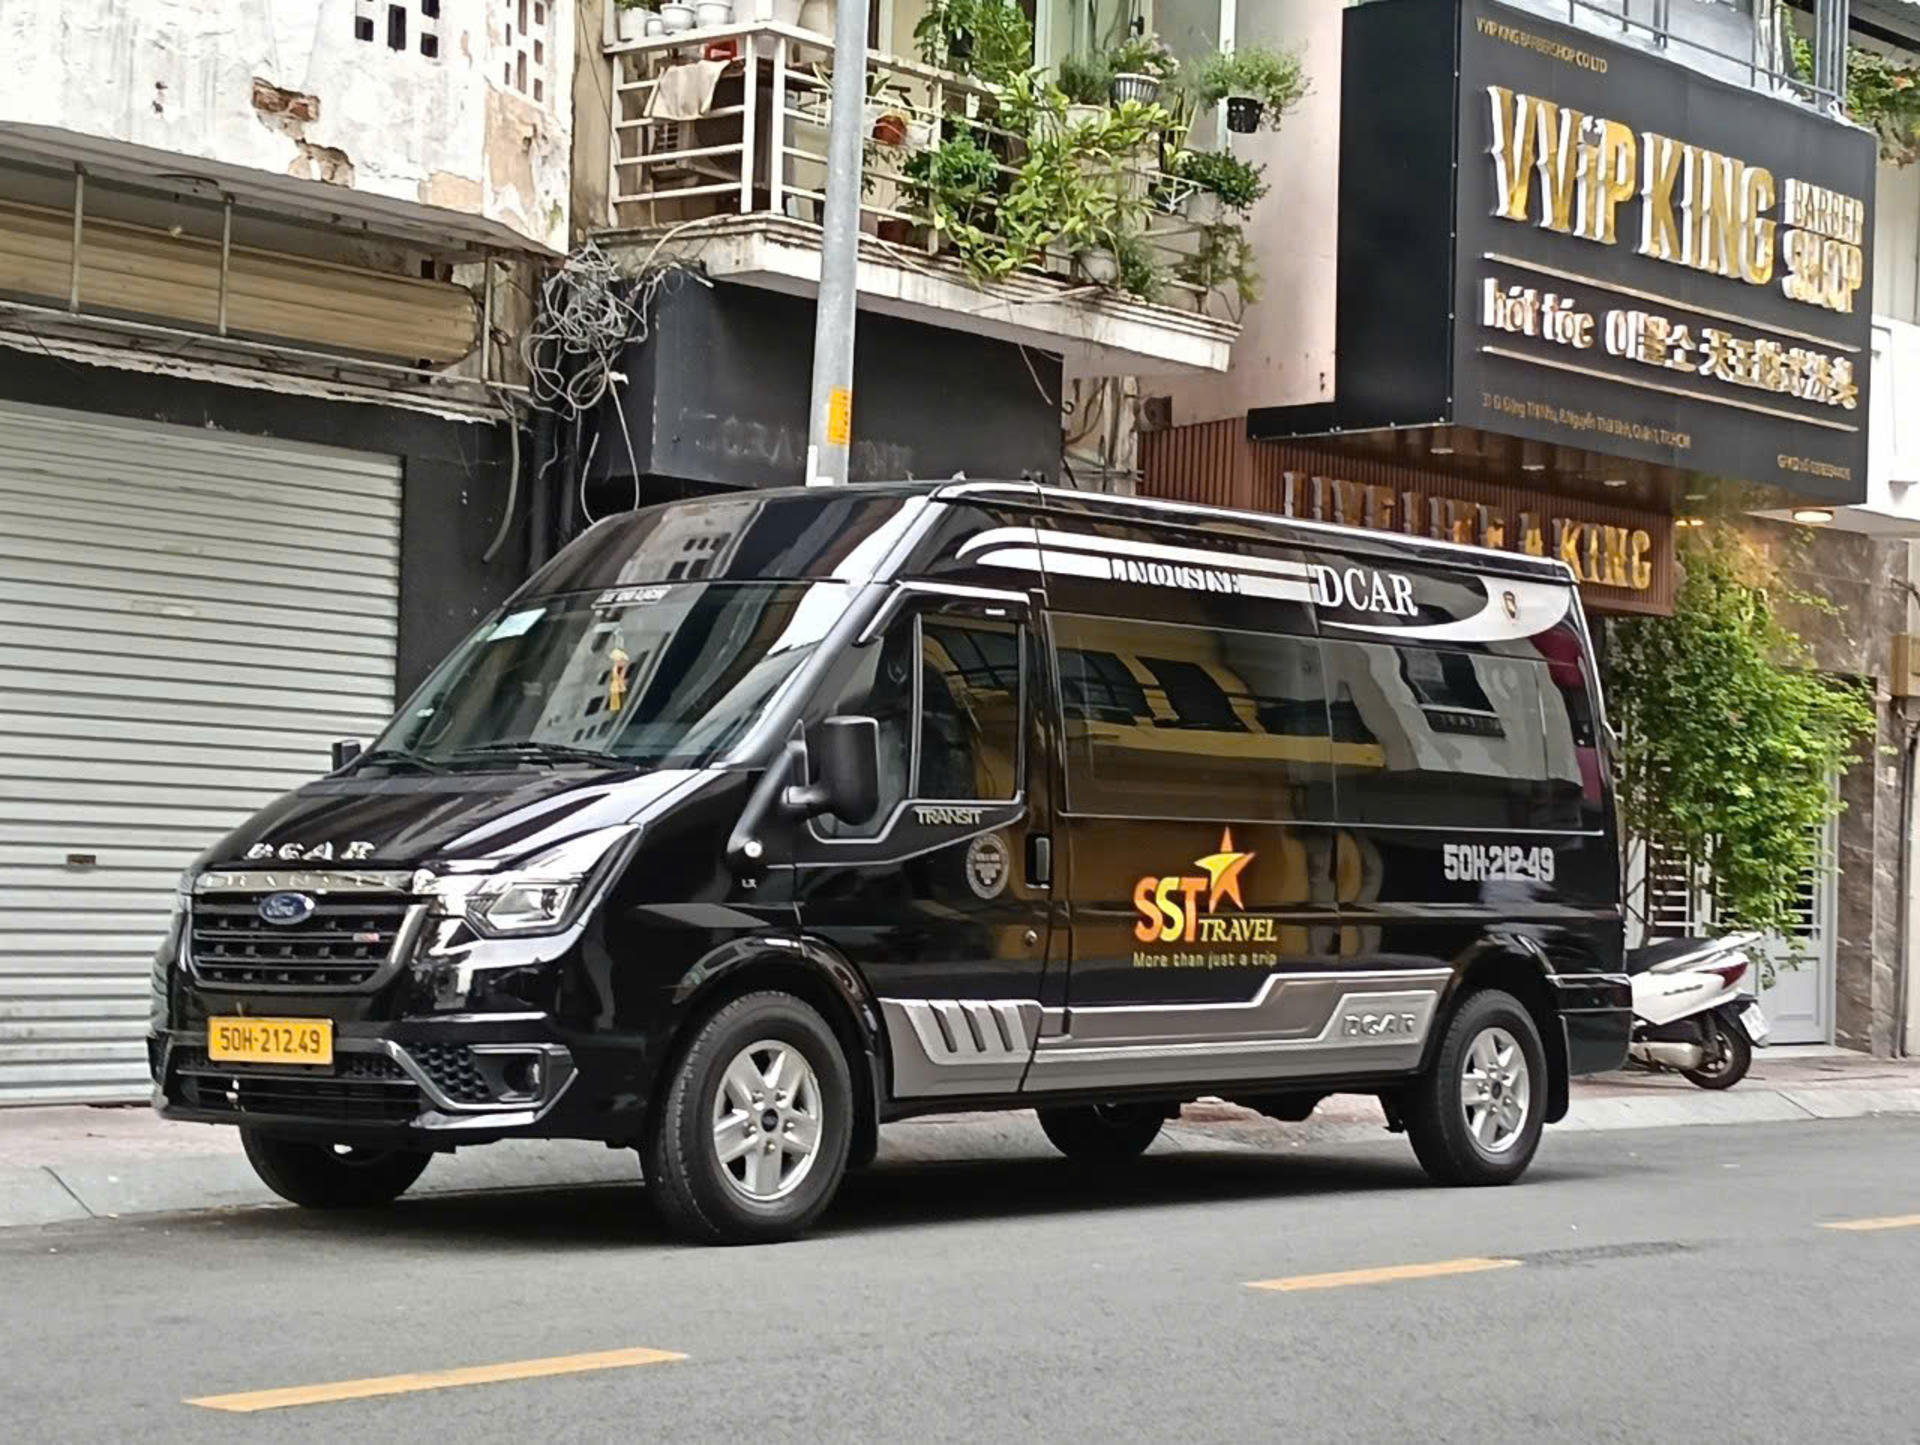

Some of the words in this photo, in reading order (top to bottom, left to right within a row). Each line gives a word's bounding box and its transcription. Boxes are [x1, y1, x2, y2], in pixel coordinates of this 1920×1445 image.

[1637, 131, 1776, 286] KING
[1783, 177, 1865, 246] BARBER
[1781, 228, 1864, 314] SHOP
[1552, 517, 1652, 591] KING
[1314, 563, 1419, 617] DCAR
[913, 806, 983, 825] TRANSIT
[1133, 876, 1209, 943] SST
[1199, 918, 1278, 942] TRAVEL
[1132, 951, 1169, 968] More
[1173, 951, 1205, 967] than
[1207, 952, 1236, 970] just
[1239, 954, 1248, 963] a
[1251, 951, 1278, 968] trip
[219, 1026, 321, 1054] 50H-212.49
